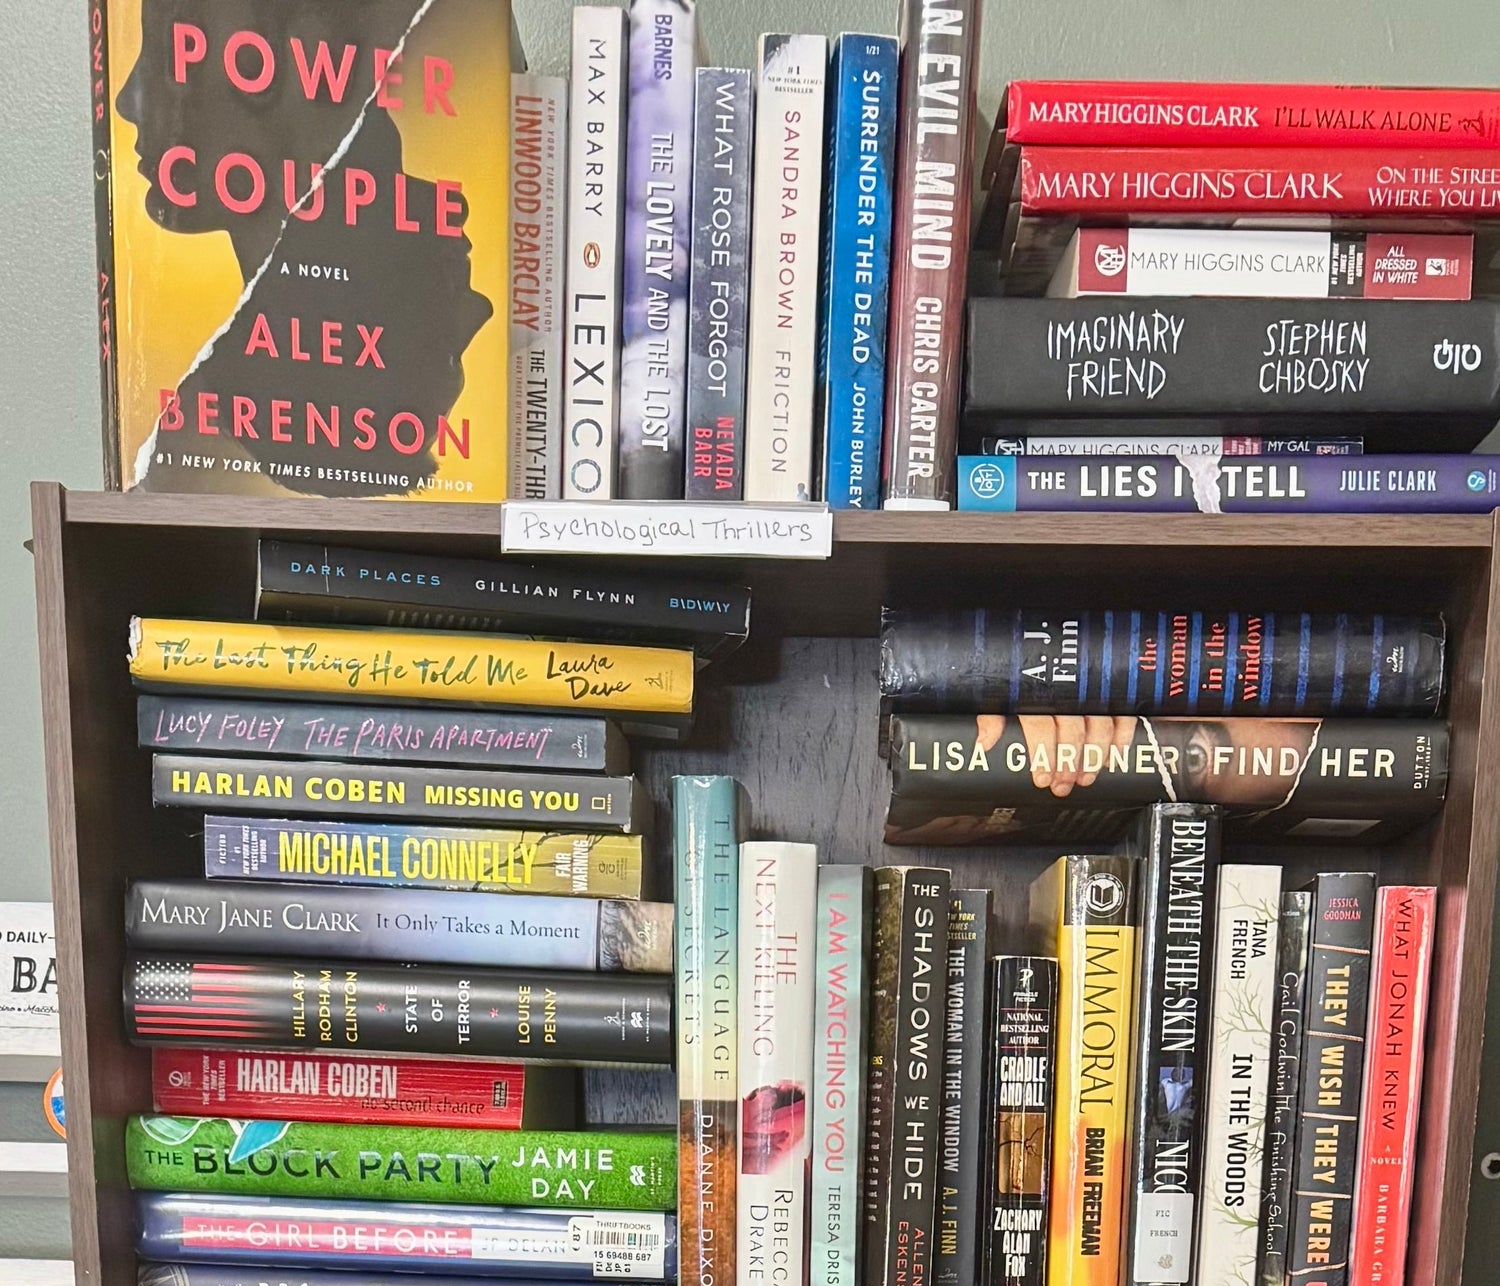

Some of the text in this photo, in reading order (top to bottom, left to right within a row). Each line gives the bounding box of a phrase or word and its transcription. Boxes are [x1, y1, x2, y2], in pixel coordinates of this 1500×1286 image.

[172, 22, 458, 118] POWER
[584, 38, 608, 218] MAX BARRY
[1028, 101, 1452, 134] MARY HIGGINS CLARK I'LL WALK ALONE
[158, 144, 466, 238] COUPLE
[1131, 250, 1327, 274] MARY HIGGINS CLARK
[1375, 258, 1419, 272] DRESSED
[1386, 245, 1406, 258] ALL
[280, 261, 350, 282] A NOVEL
[1372, 270, 1419, 285] IN WHITE
[771, 109, 802, 475] SANDRA BROWN FRICTION
[244, 313, 388, 370] ALEX
[1046, 308, 1185, 361] IMAGINARY
[1262, 320, 1369, 357] STEPHEN
[1066, 356, 1168, 401] FRIEND
[1259, 356, 1370, 395] CHBOSKY
[159, 388, 471, 461] BERENSON
[156, 452, 475, 493] #1 NEW YORK TIMES BESTSELLING AUTHOR
[1028, 465, 1305, 498] THE LIES I TELL
[1339, 470, 1437, 492] JULIE CLARK
[520, 511, 813, 546] Psychological Thrillers
[290, 562, 442, 586] DARK PLACES
[475, 580, 635, 605] GILLIAN FLYNN
[155, 709, 554, 759] LUCY FOLEY THE PARIS APARTMENT
[908, 741, 1395, 779] LISA GARDNER FIND HER
[171, 770, 580, 811] HARLAN COBEN MISSING YOU
[279, 831, 538, 884] MICHAEL CONNELLY
[554, 851, 569, 878] FAIR
[572, 839, 588, 893] WARNING
[140, 898, 581, 940] MARY JANE CLARK It Only Takes a Moment
[1231, 919, 1247, 981] FRENCH
[1250, 919, 1268, 959] TANA
[1001, 1024, 1049, 1033] BESTSELLING
[1006, 1013, 1043, 1022] NATIONAL
[1382, 898, 1413, 1130] WHAT JONAH KNEW
[1009, 1036, 1040, 1045] AUTHOR
[1000, 1056, 1046, 1082] CRADLE
[1023, 1082, 1045, 1106] ALL
[1223, 1053, 1253, 1209] IN THE WOODS
[512, 1146, 615, 1171] JAMIE
[532, 1178, 595, 1200] DAY
[596, 1220, 652, 1231] THRIFTBOOKS
[749, 1204, 769, 1280] DRAKE
[594, 1250, 652, 1261] 15 69488 687
